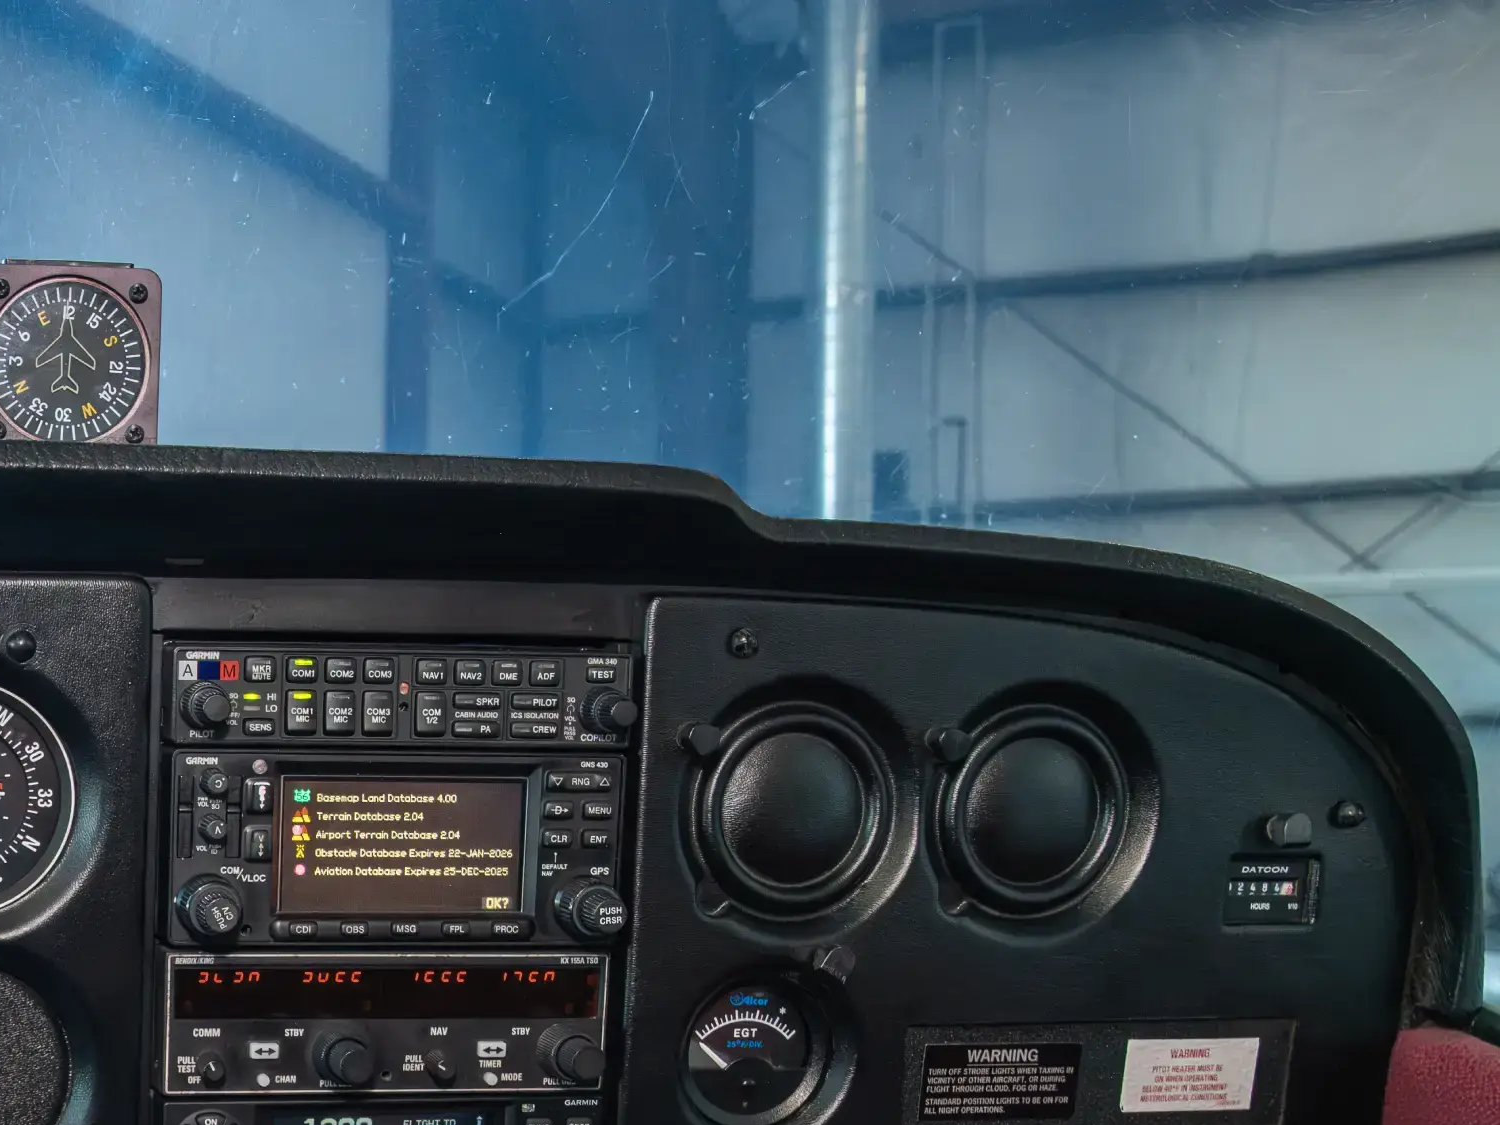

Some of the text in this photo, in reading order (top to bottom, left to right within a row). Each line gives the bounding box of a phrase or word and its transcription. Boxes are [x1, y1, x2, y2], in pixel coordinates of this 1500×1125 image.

[87, 313, 102, 329] 15
[186, 651, 219, 660] GARMIN
[252, 665, 271, 673] MKR
[330, 670, 354, 678] COM2
[368, 670, 392, 678] COM3
[460, 672, 481, 680] NAV2
[592, 671, 614, 679] TEST
[476, 698, 499, 706] SPKR
[533, 699, 557, 707] PILOT
[249, 723, 272, 731] SENS
[572, 778, 590, 786] RNG
[38, 789, 52, 808] 33
[316, 794, 457, 803] Basemap Land Database 4.00
[317, 812, 424, 821] Terrain Database 2.04
[316, 831, 460, 841] Airport Terrain Database 2.04
[551, 835, 568, 843] CLR
[590, 836, 607, 844] ENT
[315, 849, 513, 859] Obstacle Database Expires 22-JAN-2026
[315, 867, 508, 877] Aviation Database Expires 25-DEC-2025
[590, 867, 609, 875] GPS
[486, 897, 509, 909] OK?
[600, 907, 622, 915] PUSH
[600, 916, 622, 924] CRSR
[295, 925, 311, 934] CDI
[346, 925, 364, 934] OBS
[396, 924, 416, 933] MSG
[450, 925, 464, 933] FPL
[495, 925, 519, 934] PROC
[193, 1029, 220, 1037] COMM
[284, 1029, 304, 1037] STBY
[430, 1027, 448, 1035] NAV
[511, 1028, 530, 1036] STBY
[734, 1028, 757, 1037] EGT
[967, 1049, 1039, 1063] WARNING
[479, 1060, 502, 1068] TIMER
[275, 1075, 296, 1084] CHAN
[501, 1073, 523, 1081] MODE
[961, 1106, 1005, 1114] OPERATIONS.
